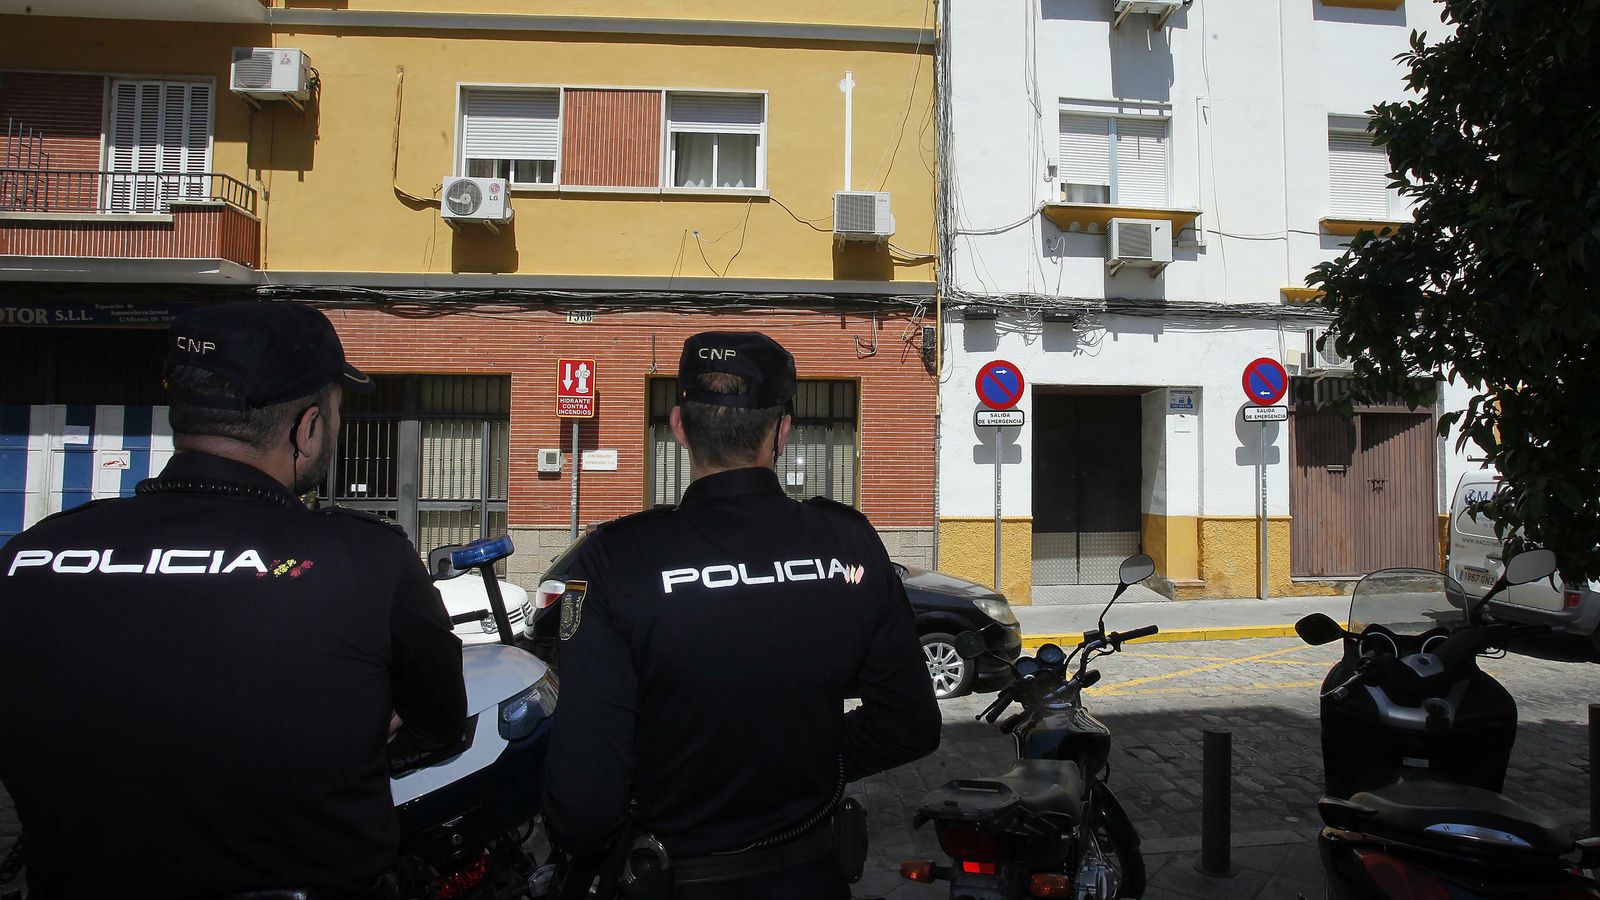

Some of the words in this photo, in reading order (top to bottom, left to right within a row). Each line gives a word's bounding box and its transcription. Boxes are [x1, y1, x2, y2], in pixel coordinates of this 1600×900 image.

[55, 309, 93, 321] S.L.L.
[177, 336, 216, 355] CNP
[698, 347, 737, 361] CNP
[7, 548, 269, 577] POLICIA
[661, 558, 848, 594] POLICIA
